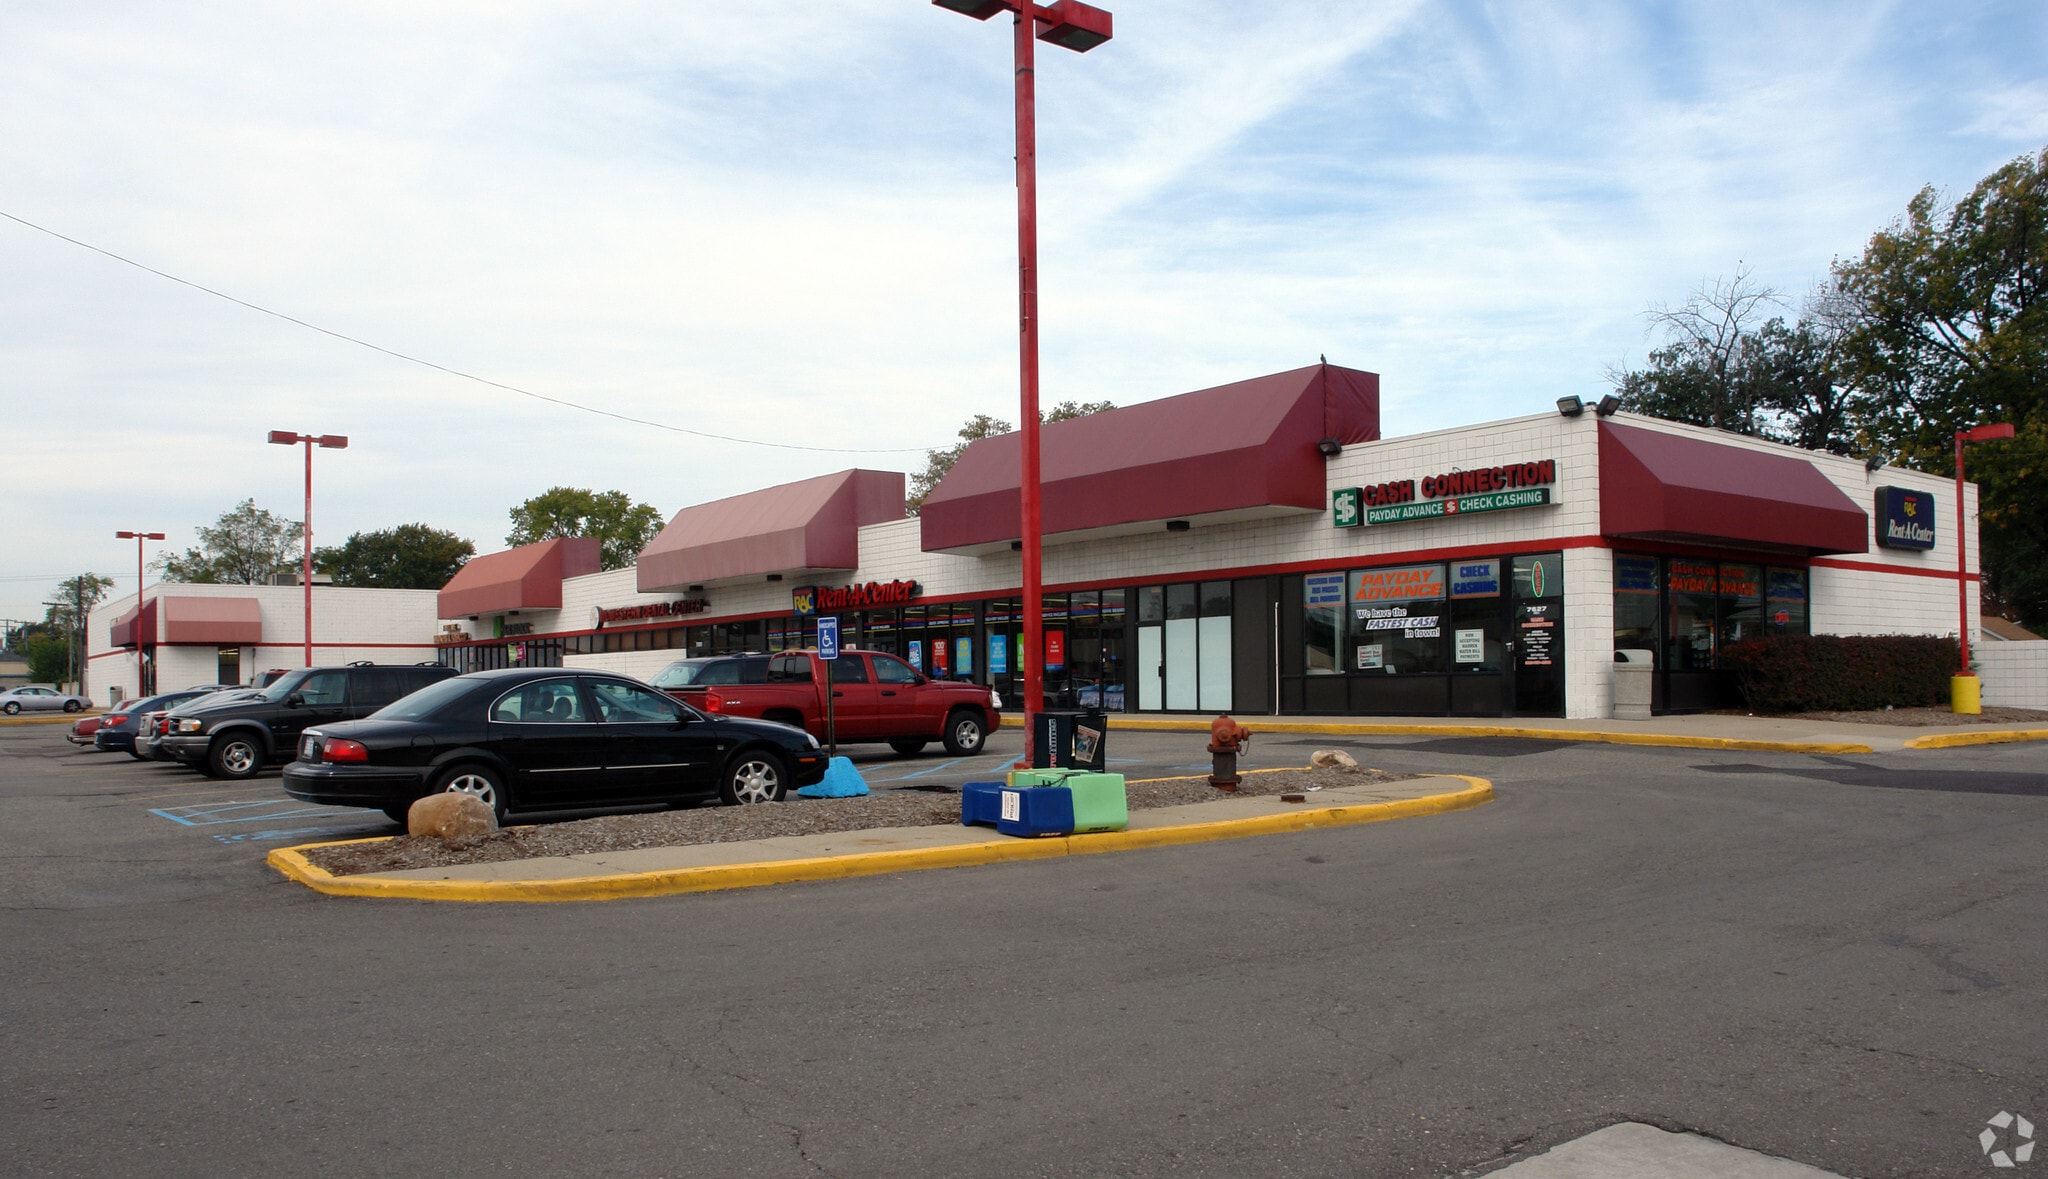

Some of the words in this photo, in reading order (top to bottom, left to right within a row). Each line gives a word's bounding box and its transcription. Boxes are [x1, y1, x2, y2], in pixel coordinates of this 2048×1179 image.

[1363, 480, 1415, 506] CASH
[1421, 459, 1556, 498] CONNECTION
[1369, 506, 1401, 522] PAYDAY
[1402, 503, 1444, 518] ADVANCE
[1460, 497, 1494, 511] CHECK
[1496, 491, 1542, 507] CASHING
[1888, 519, 1934, 543] Rent-A-Center
[1361, 568, 1434, 586] PAYDAY
[1460, 565, 1490, 578] CHECK
[1354, 582, 1443, 600] ADVANCE
[1453, 580, 1497, 594] CASHING
[1670, 577, 1708, 592] PAYDAY
[642, 602, 670, 618] DENTAL
[671, 599, 704, 615] CENTER
[794, 592, 814, 613] RAC
[1356, 609, 1371, 619] We
[1371, 608, 1391, 618] have
[1392, 607, 1407, 617] the
[1368, 619, 1408, 629] FASTEST
[1410, 617, 1437, 628] CASH
[1404, 628, 1414, 638] in
[1415, 627, 1440, 638] town!
